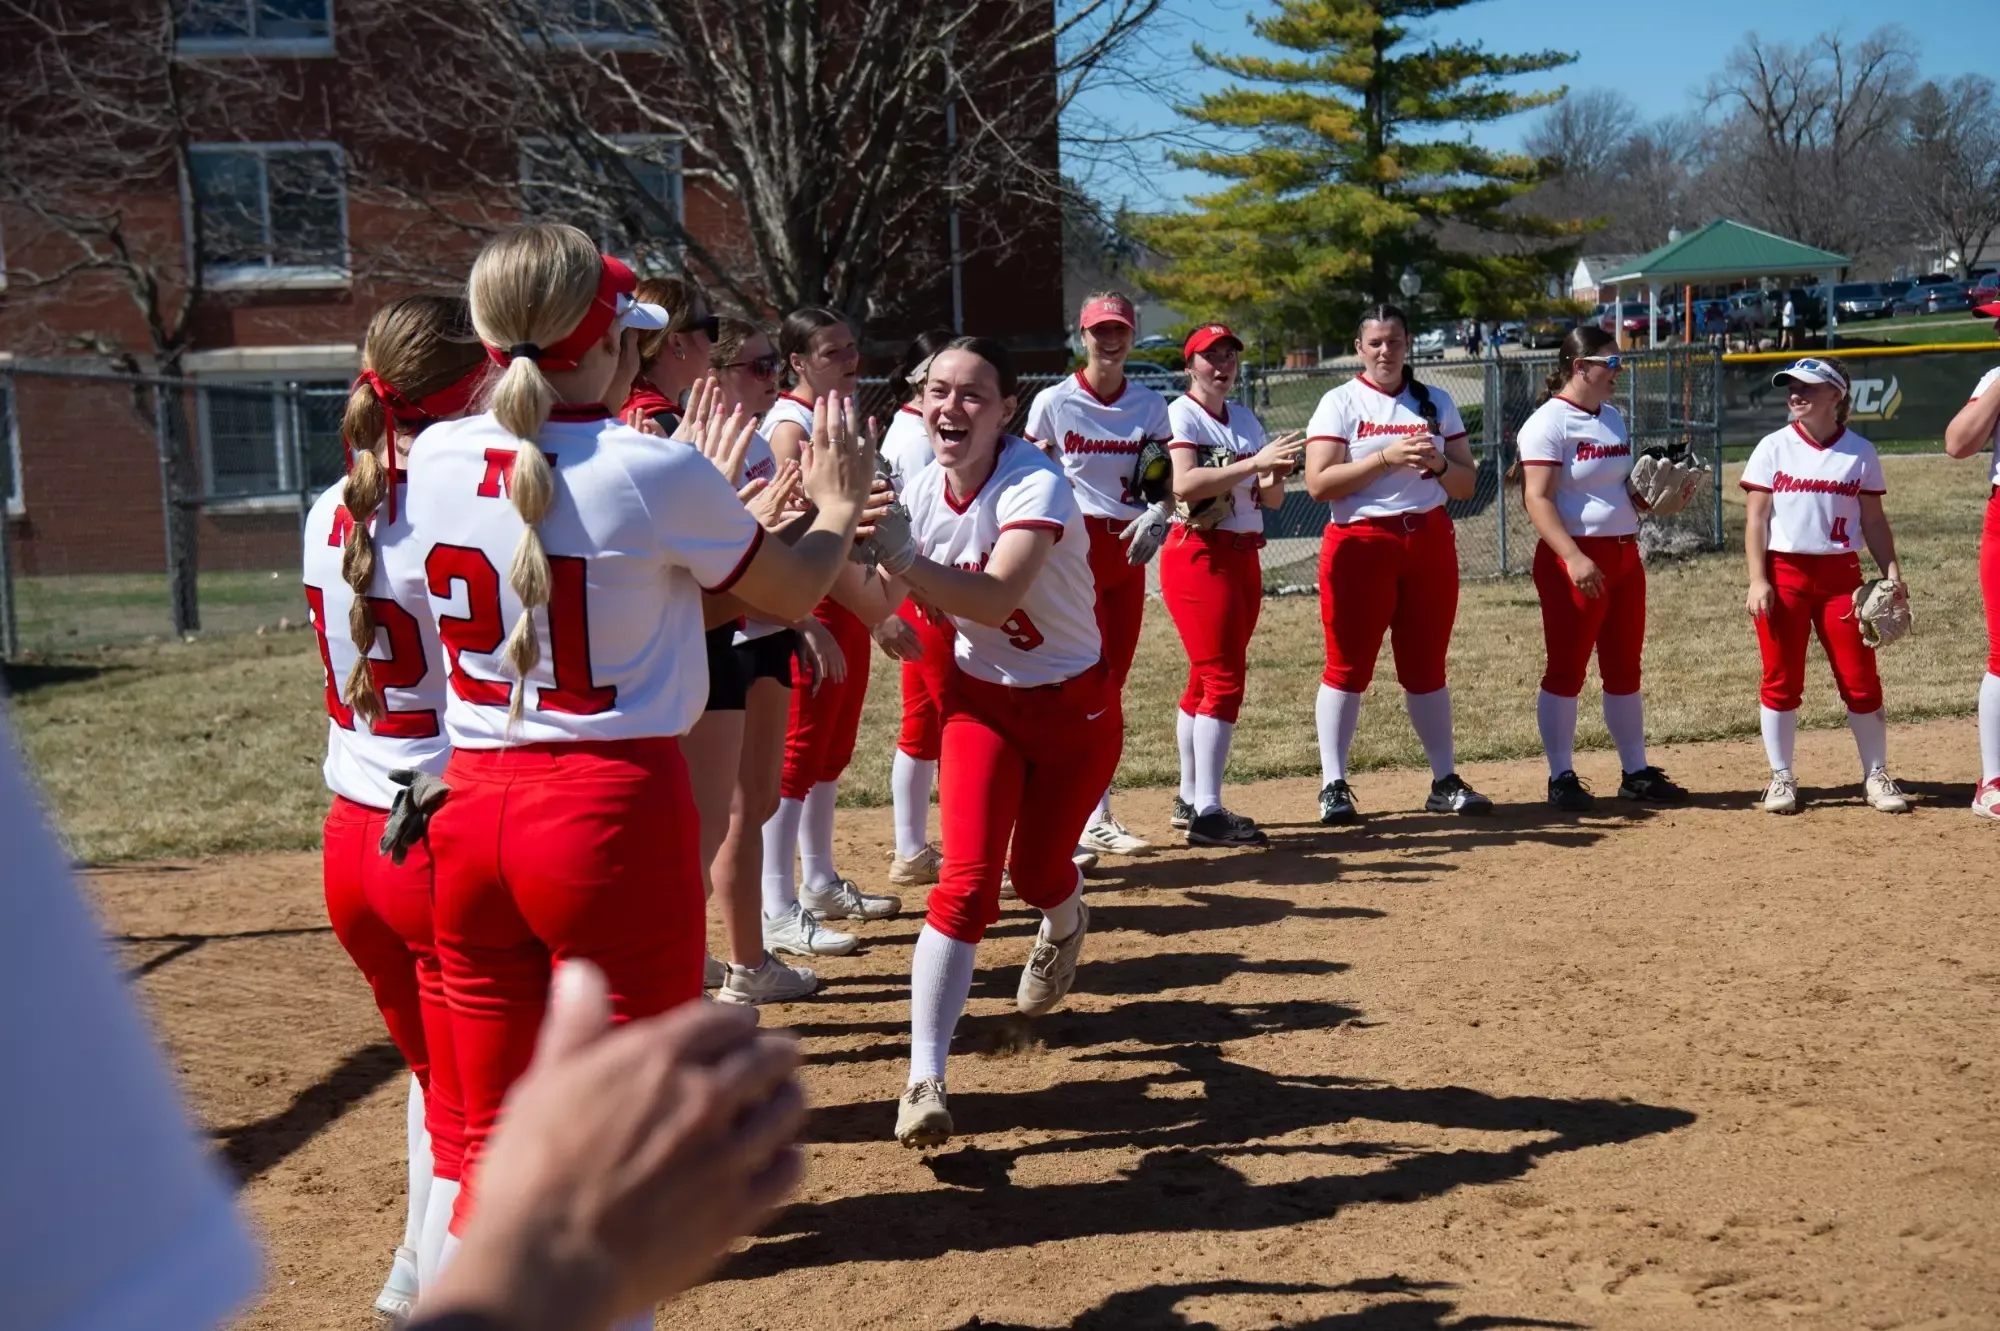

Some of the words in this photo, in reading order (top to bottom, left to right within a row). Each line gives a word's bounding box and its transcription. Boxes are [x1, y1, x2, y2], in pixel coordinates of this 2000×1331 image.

[1773, 470, 1861, 497] Monmouth
[1830, 517, 1850, 548] 4
[425, 542, 617, 715] 21
[1000, 608, 1044, 652] 9
[304, 585, 440, 738] 12
